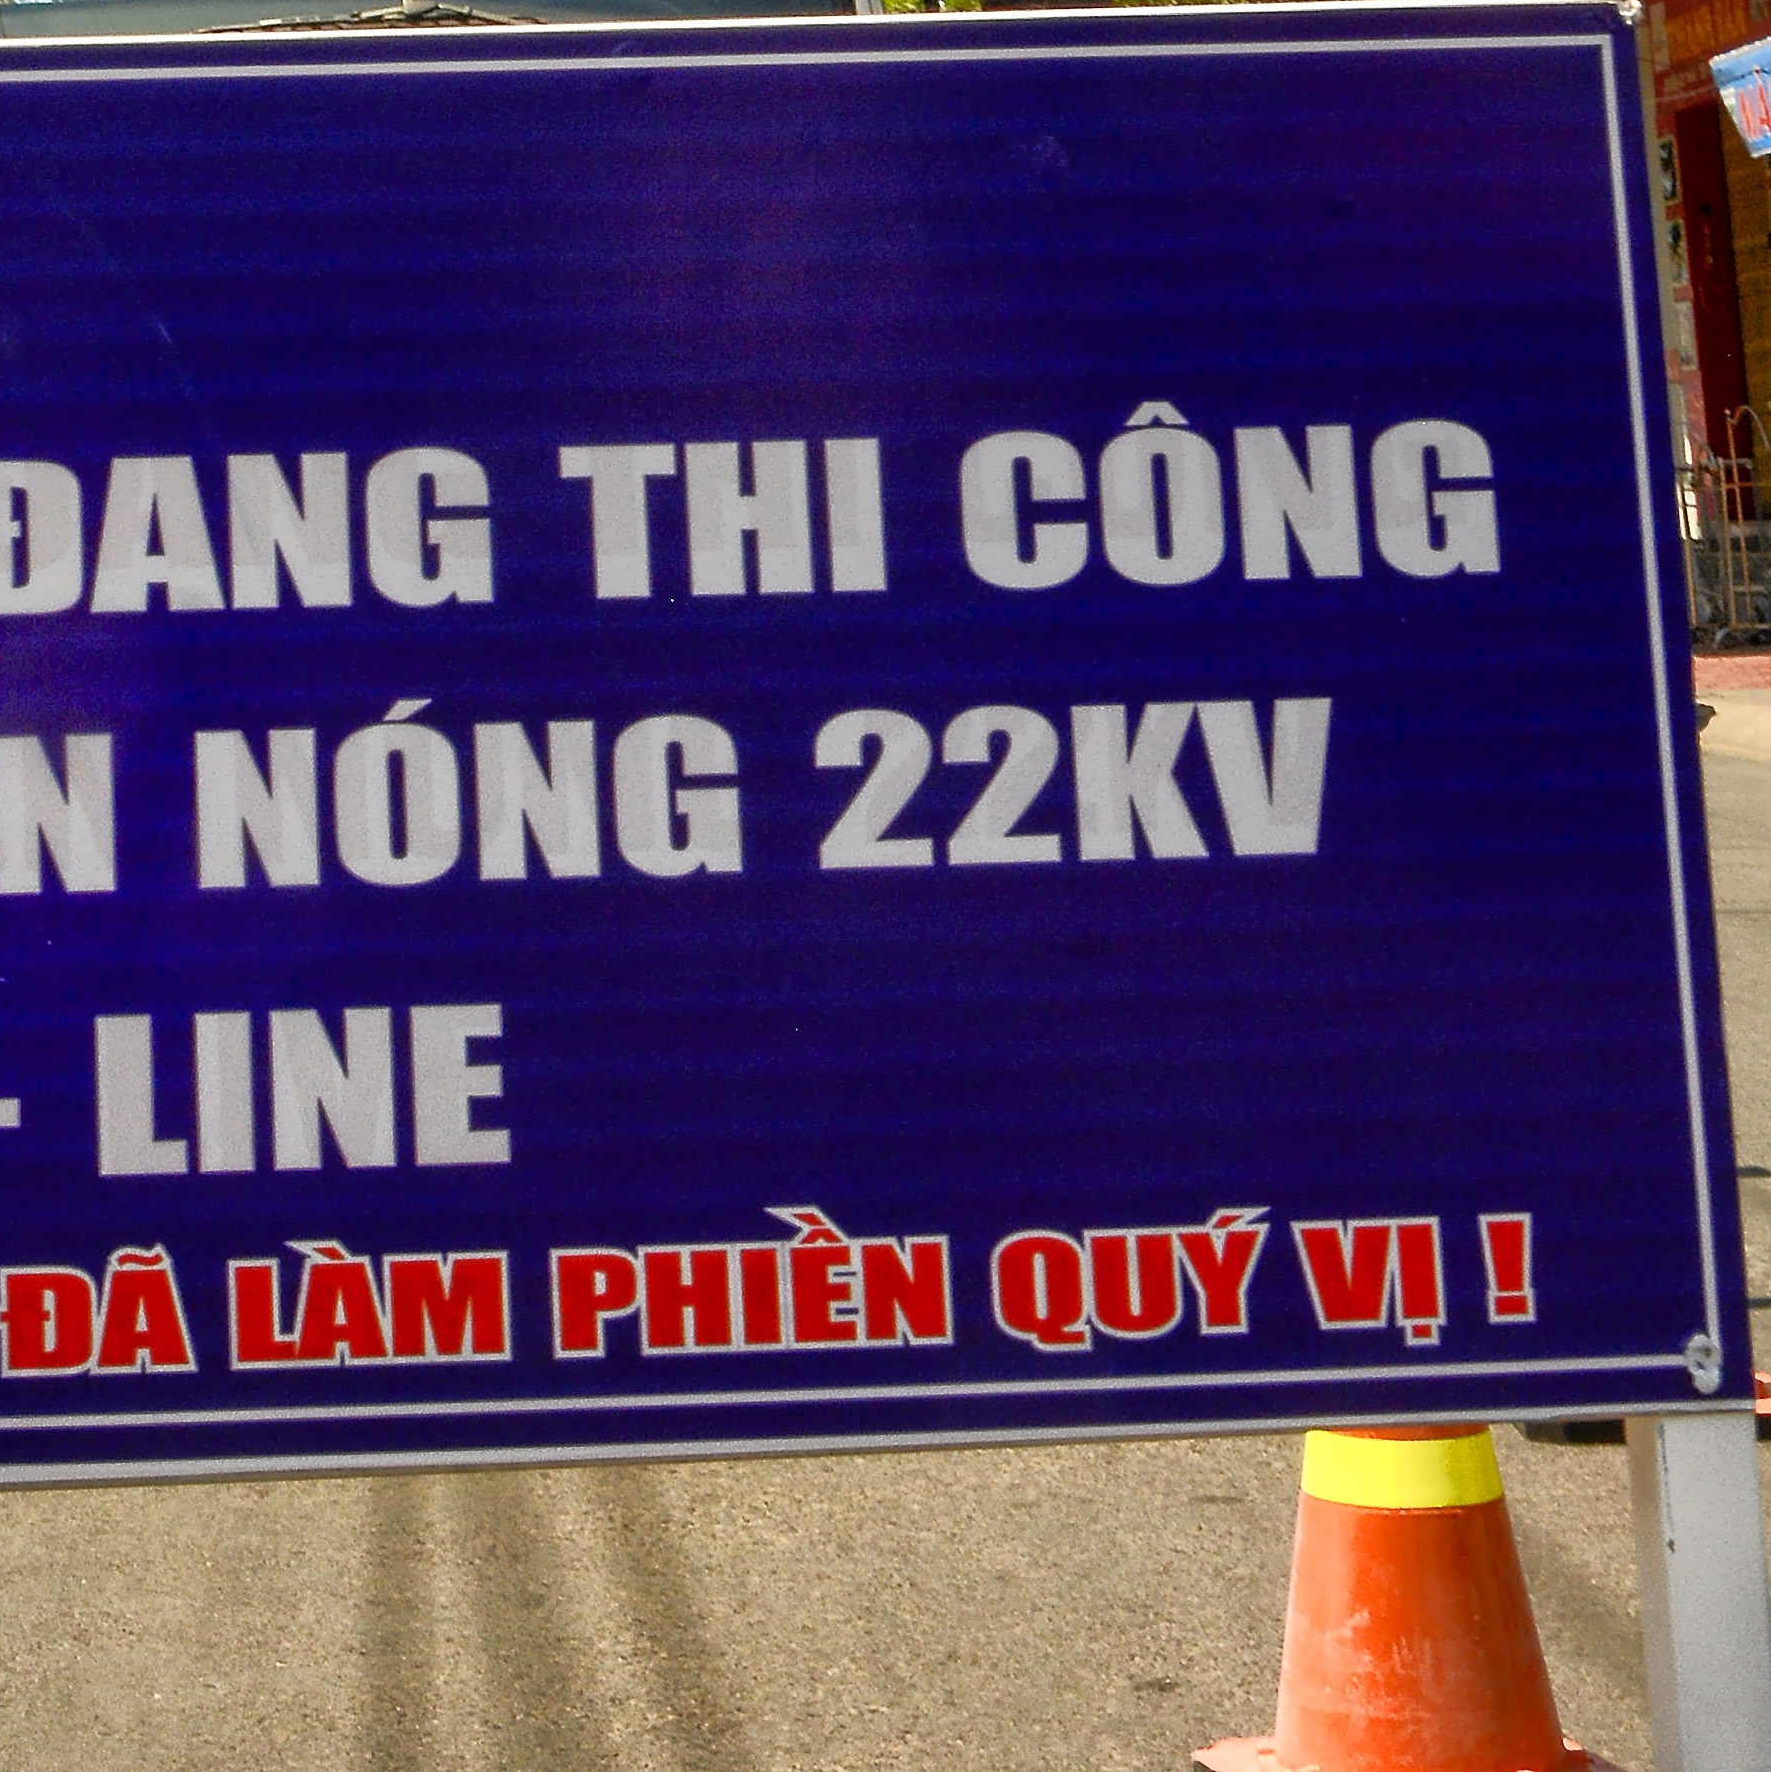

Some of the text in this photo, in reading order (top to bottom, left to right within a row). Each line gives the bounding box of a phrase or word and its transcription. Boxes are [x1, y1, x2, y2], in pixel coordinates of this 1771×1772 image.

[559, 438, 886, 599] THI
[961, 401, 1500, 589] CÔNG
[195, 698, 742, 889] NÓNG
[815, 698, 1331, 869] 22KV
[96, 1004, 510, 1175] LINE
[228, 1240, 511, 1370] LÀM
[550, 1207, 953, 1358] PHIỀN
[991, 1207, 1270, 1352] QUÝ
[1291, 1215, 1446, 1347] VỊ
[1479, 1212, 1535, 1323] !
